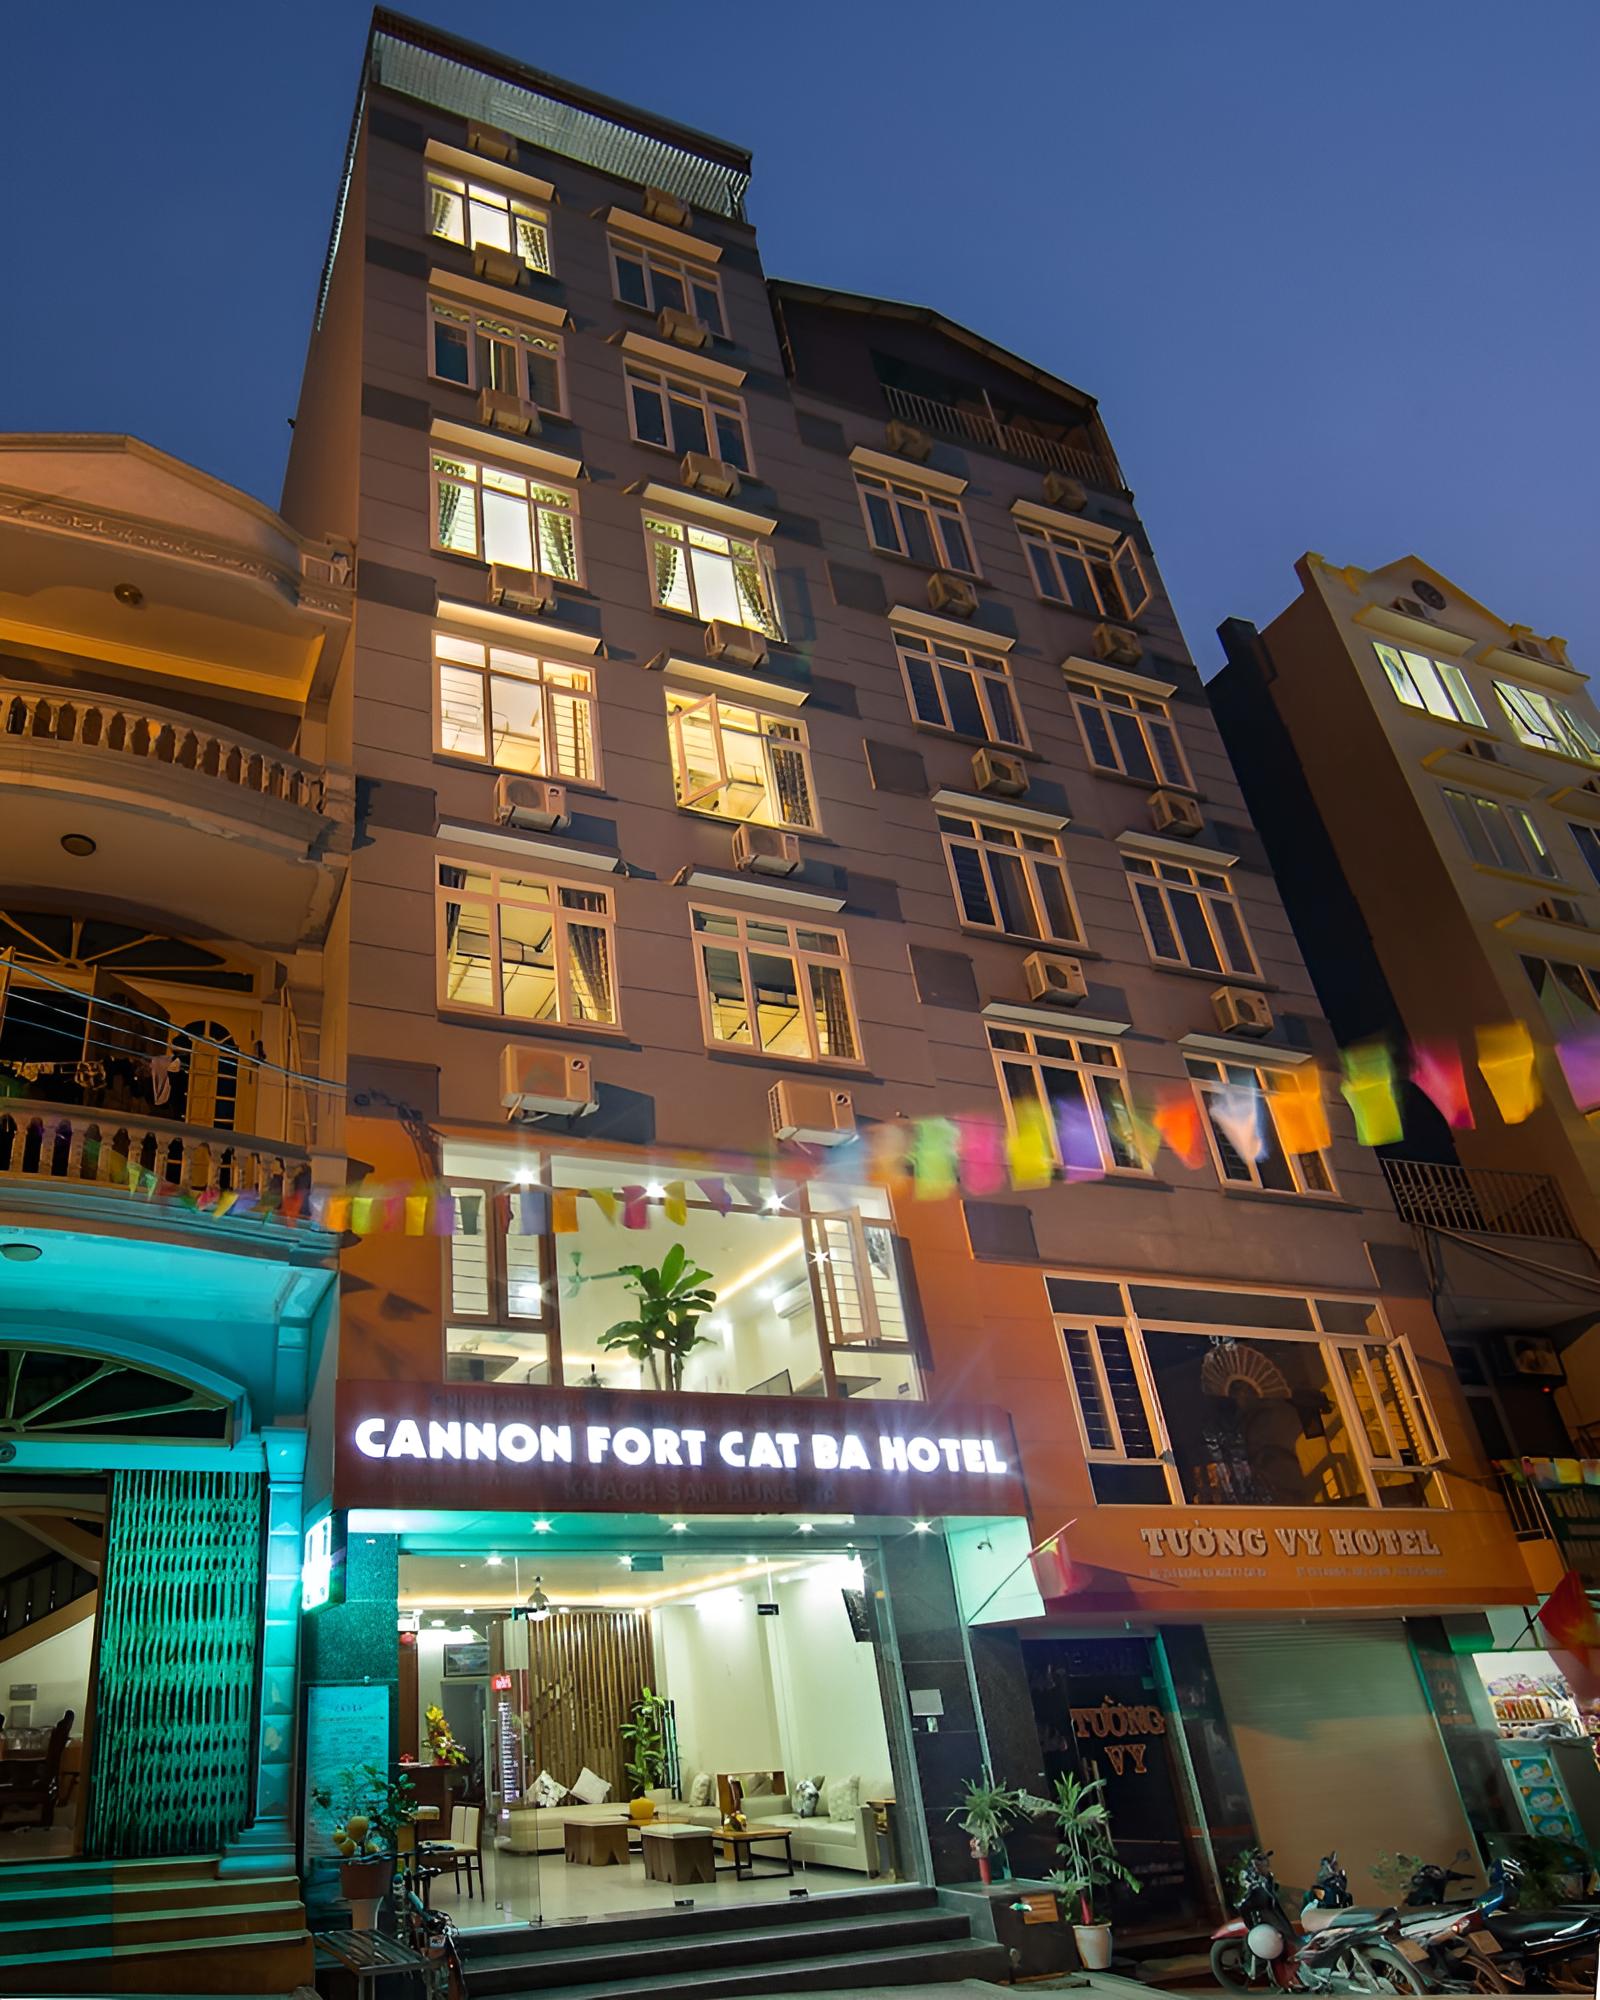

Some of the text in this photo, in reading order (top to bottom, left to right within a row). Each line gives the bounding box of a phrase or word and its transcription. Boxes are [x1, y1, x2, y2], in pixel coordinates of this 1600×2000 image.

[354, 1417, 1009, 1475] CANNON FORT CAT BA HOTEL
[1275, 1528, 1321, 1556] VY
[1329, 1528, 1441, 1556] HOTEL
[1104, 1743, 1148, 1776] VY
